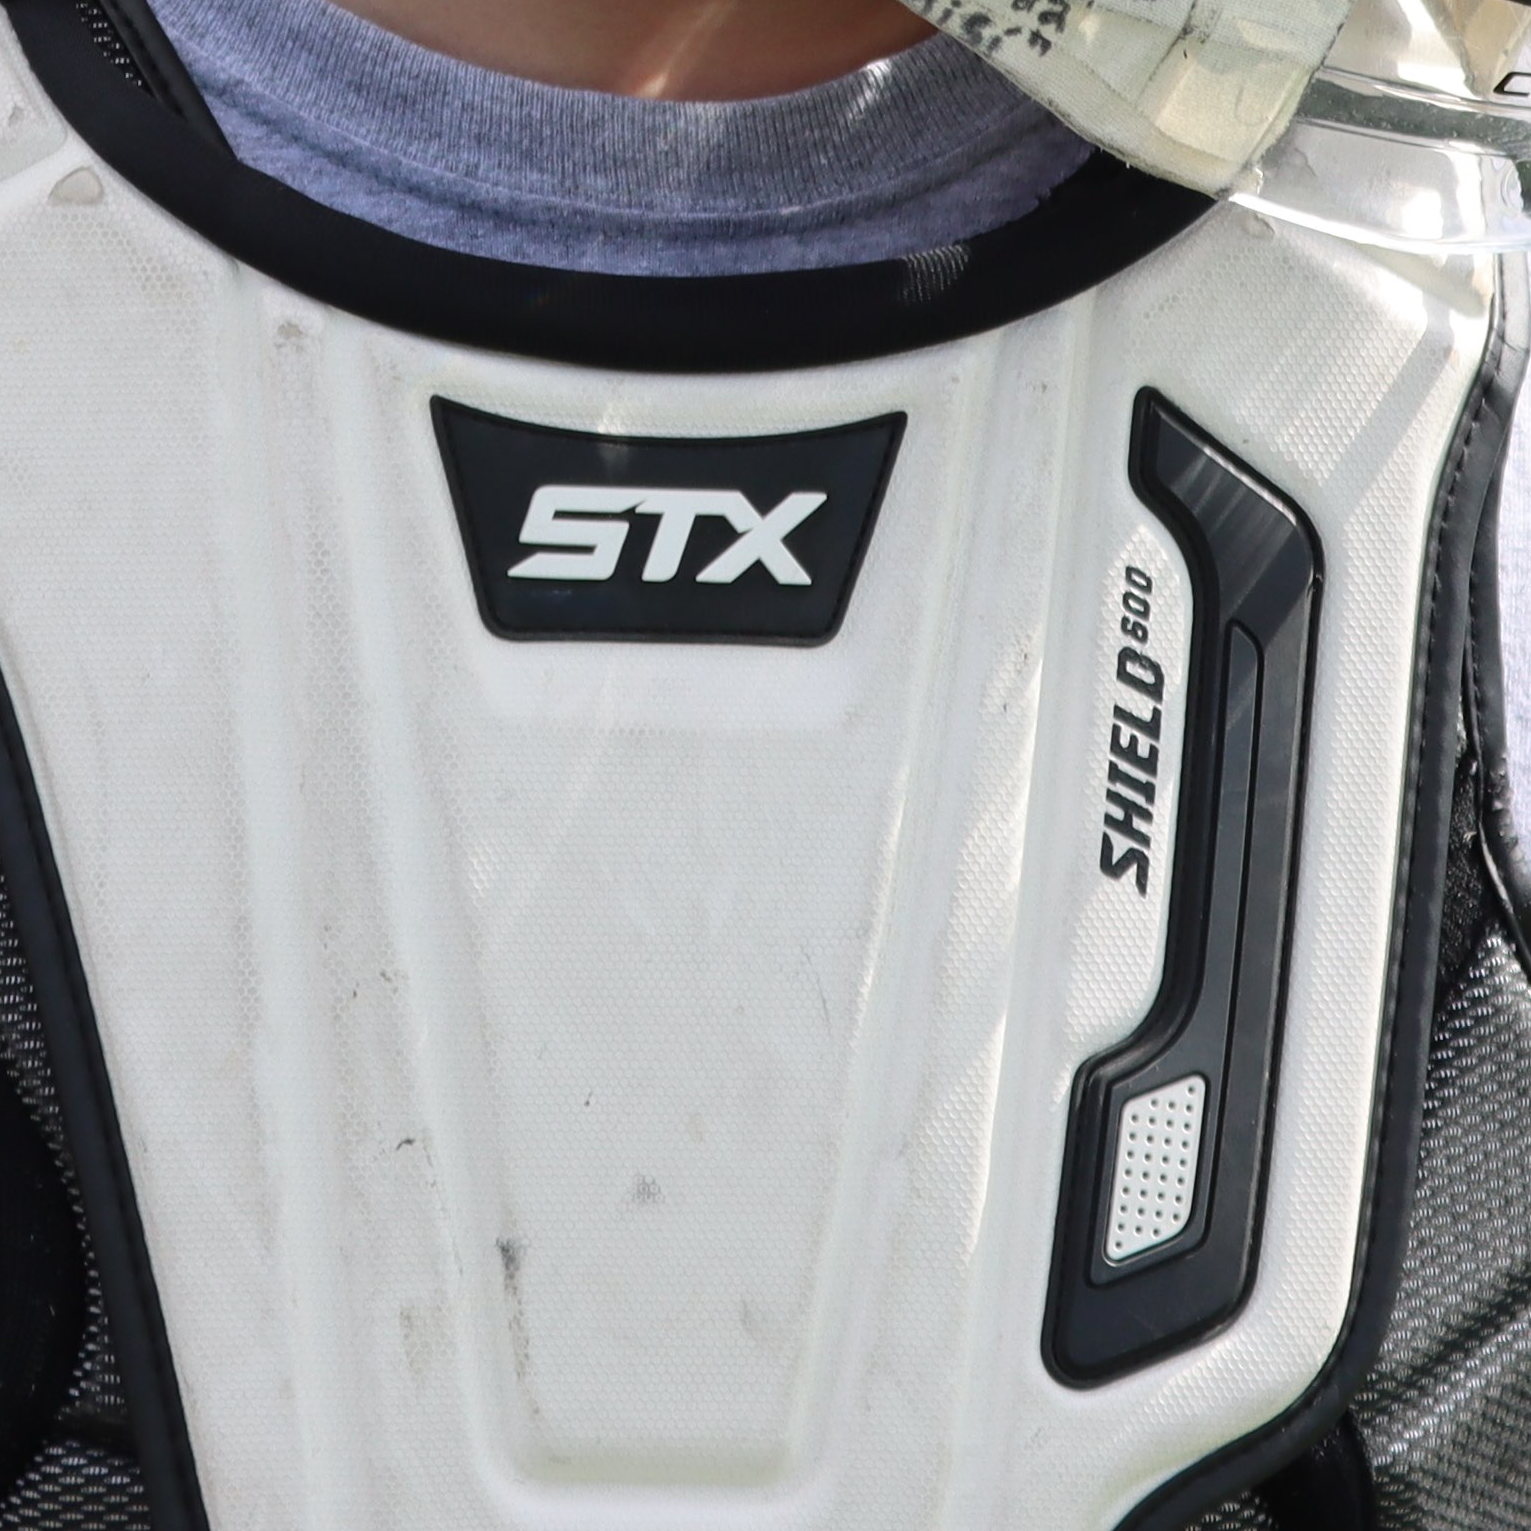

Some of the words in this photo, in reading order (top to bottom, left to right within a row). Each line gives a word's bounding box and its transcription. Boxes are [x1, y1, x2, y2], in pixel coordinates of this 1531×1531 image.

[507, 484, 828, 585] STX
[1120, 565, 1154, 641] 600
[1098, 645, 1166, 899] SHIELD
